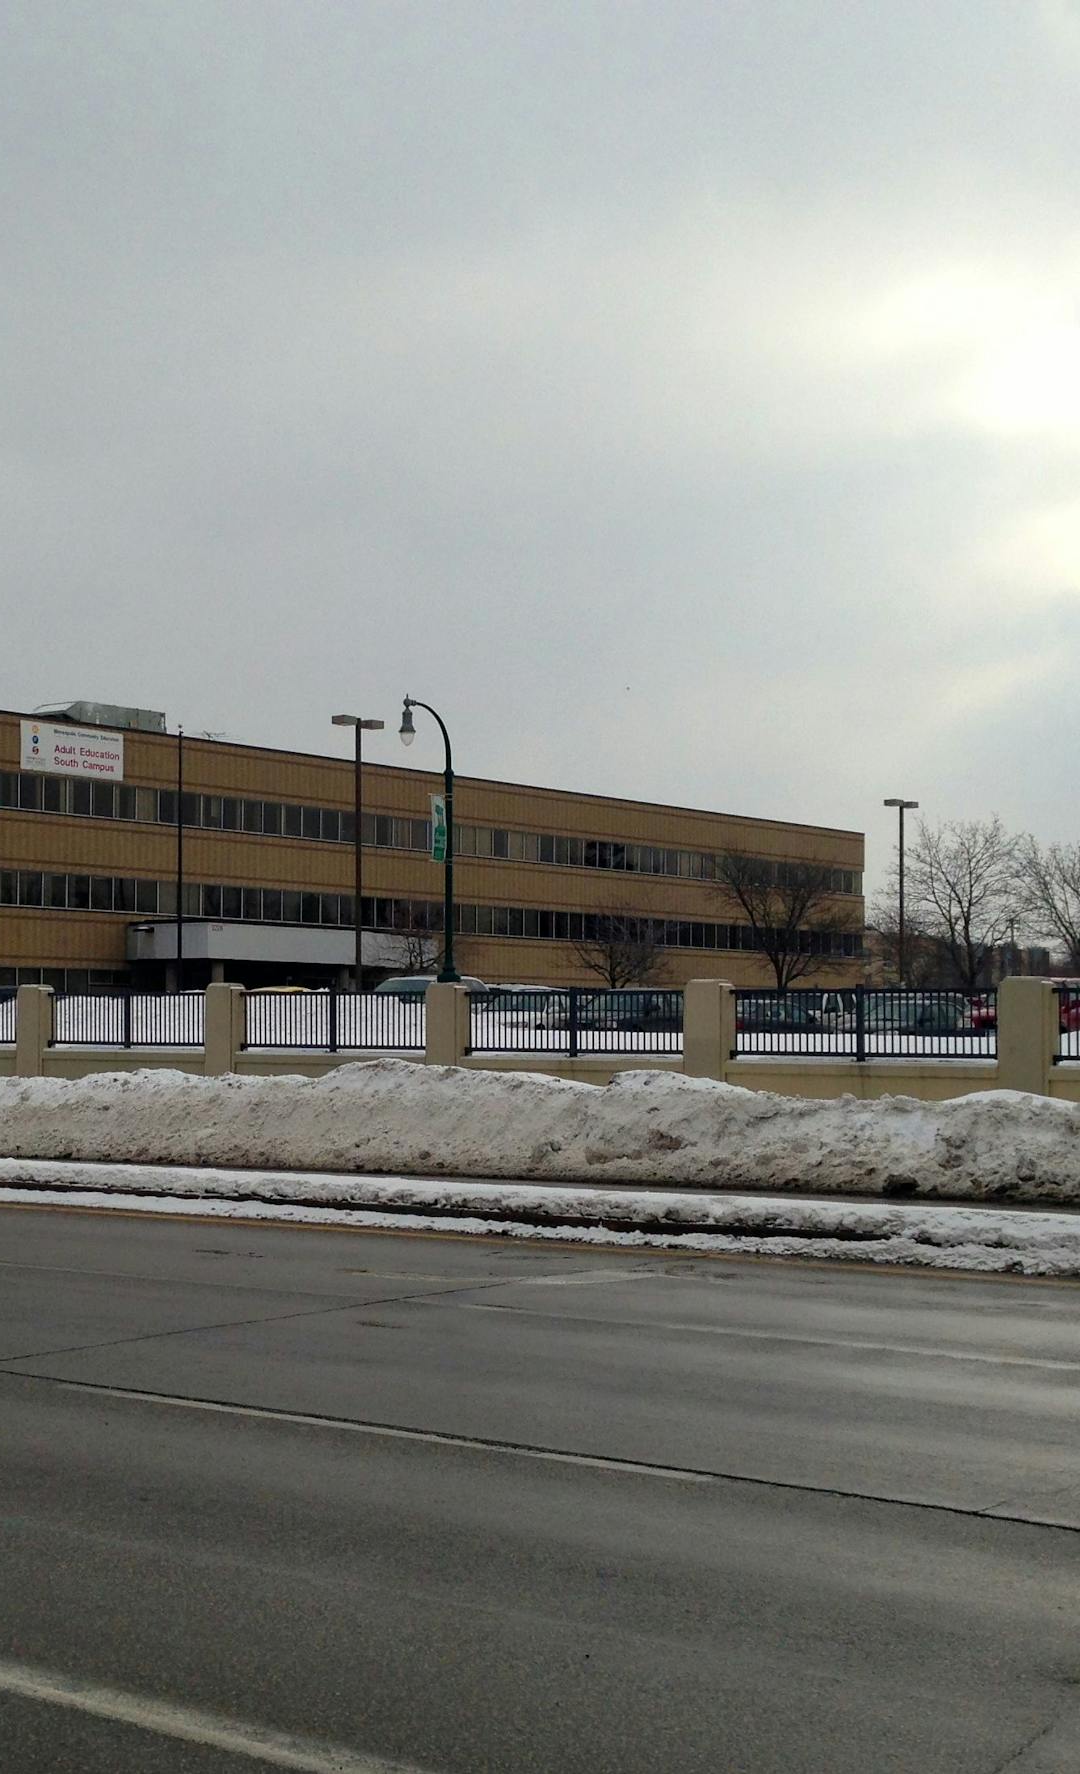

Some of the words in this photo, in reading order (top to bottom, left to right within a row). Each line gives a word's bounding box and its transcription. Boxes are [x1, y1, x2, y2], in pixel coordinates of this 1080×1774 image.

[54, 744, 76, 755] Adult
[80, 747, 120, 761] Education
[54, 756, 79, 768] South
[82, 760, 115, 772] Campus
